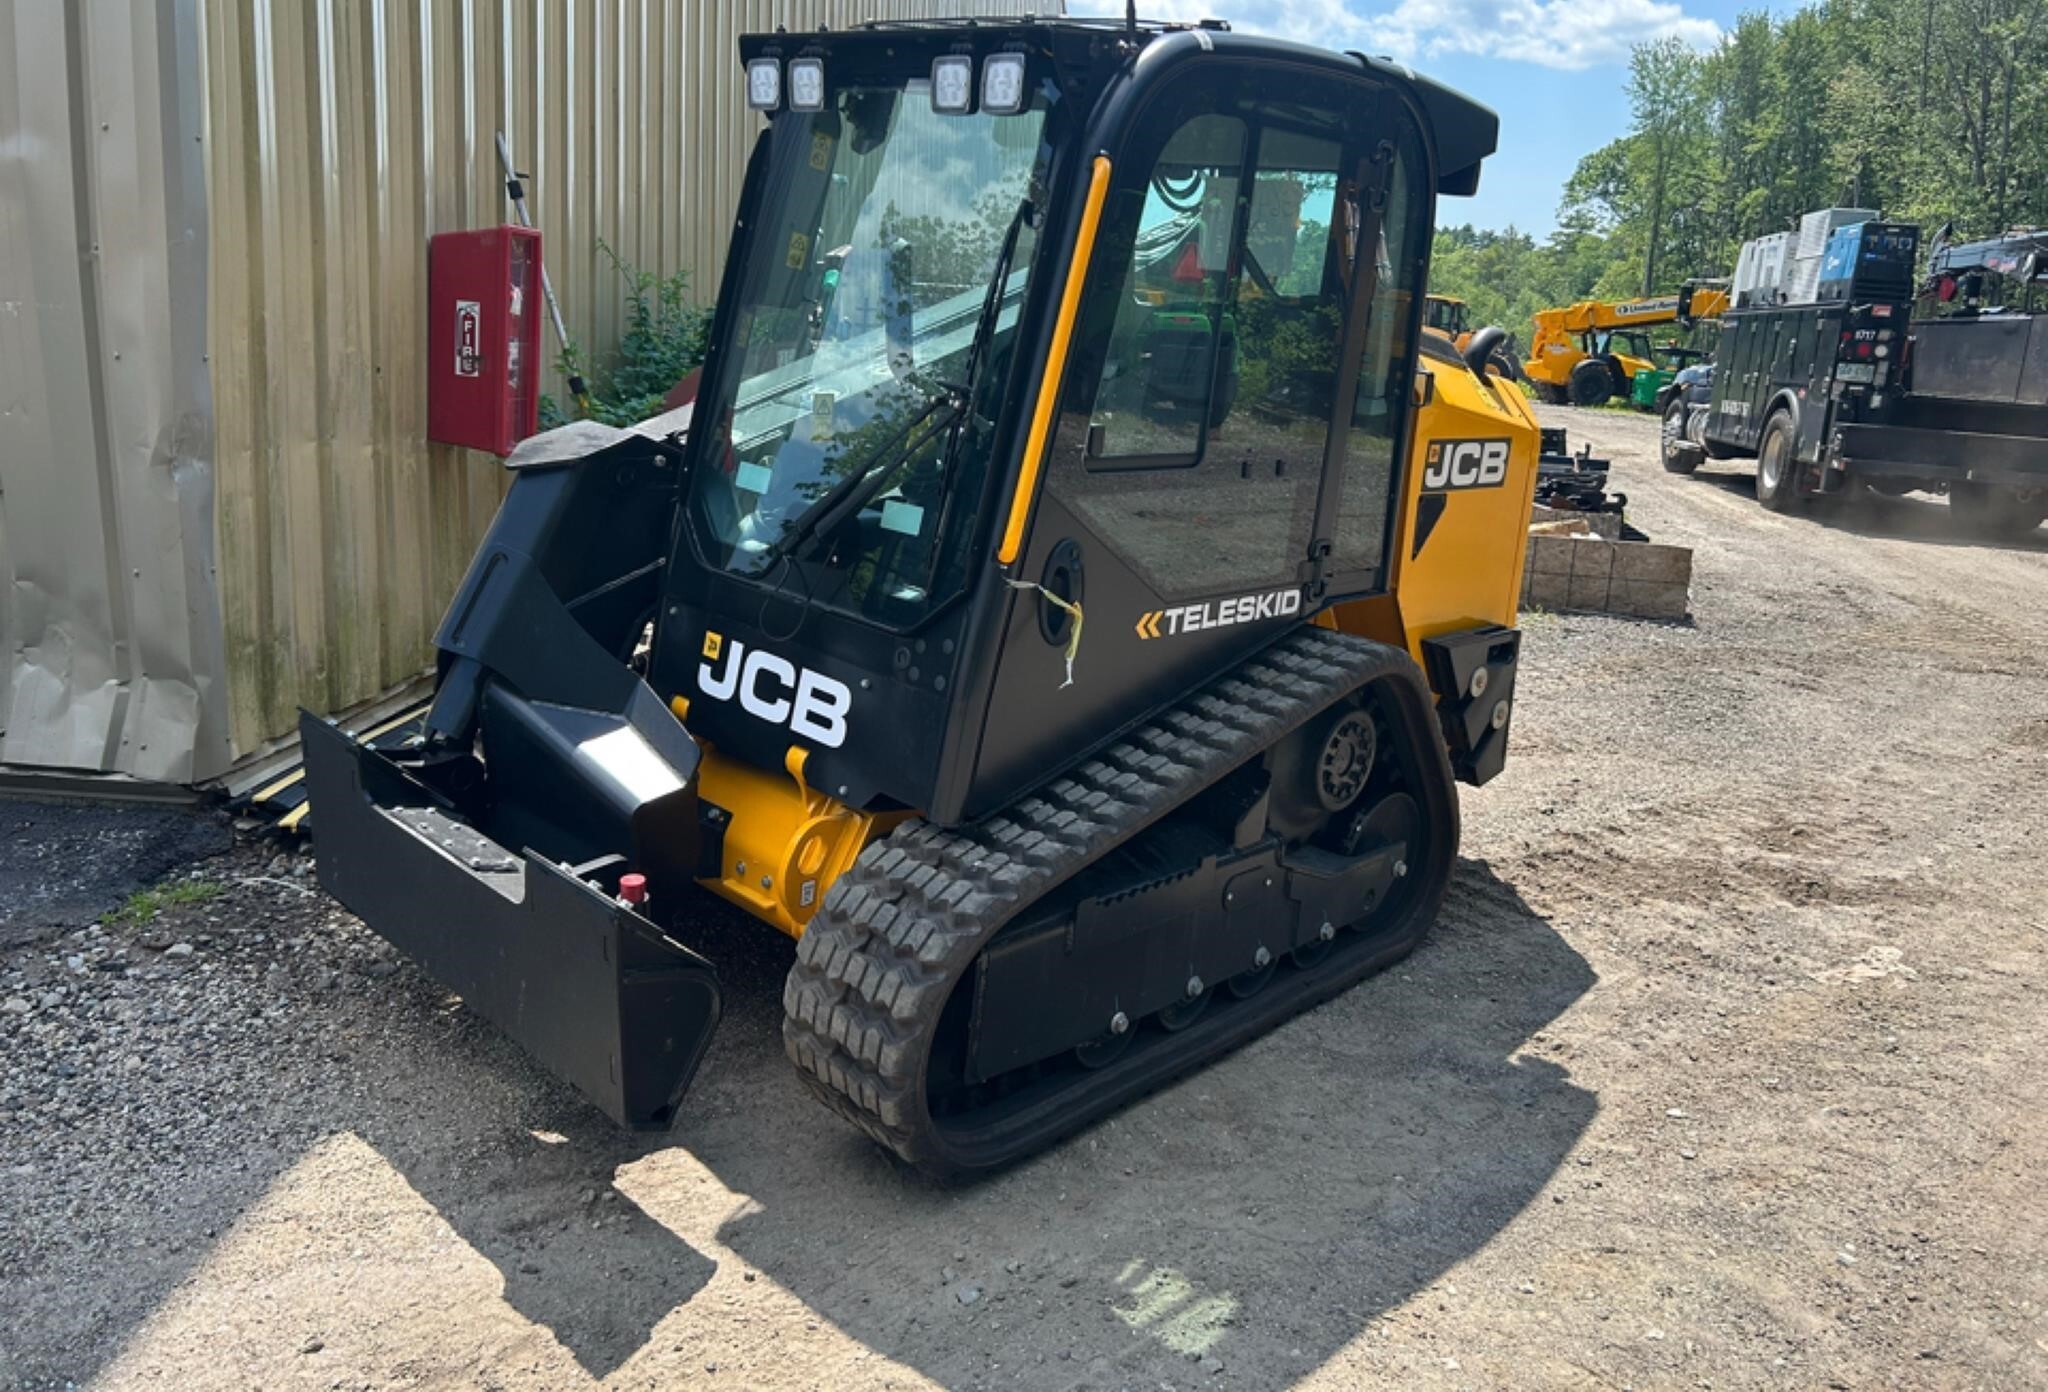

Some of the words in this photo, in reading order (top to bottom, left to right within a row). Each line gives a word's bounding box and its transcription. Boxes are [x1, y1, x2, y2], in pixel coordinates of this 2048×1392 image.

[463, 320, 473, 371] FIRE
[1424, 442, 1509, 488] JCB
[1164, 589, 1301, 636] TELESKID
[697, 639, 852, 748] JCB
